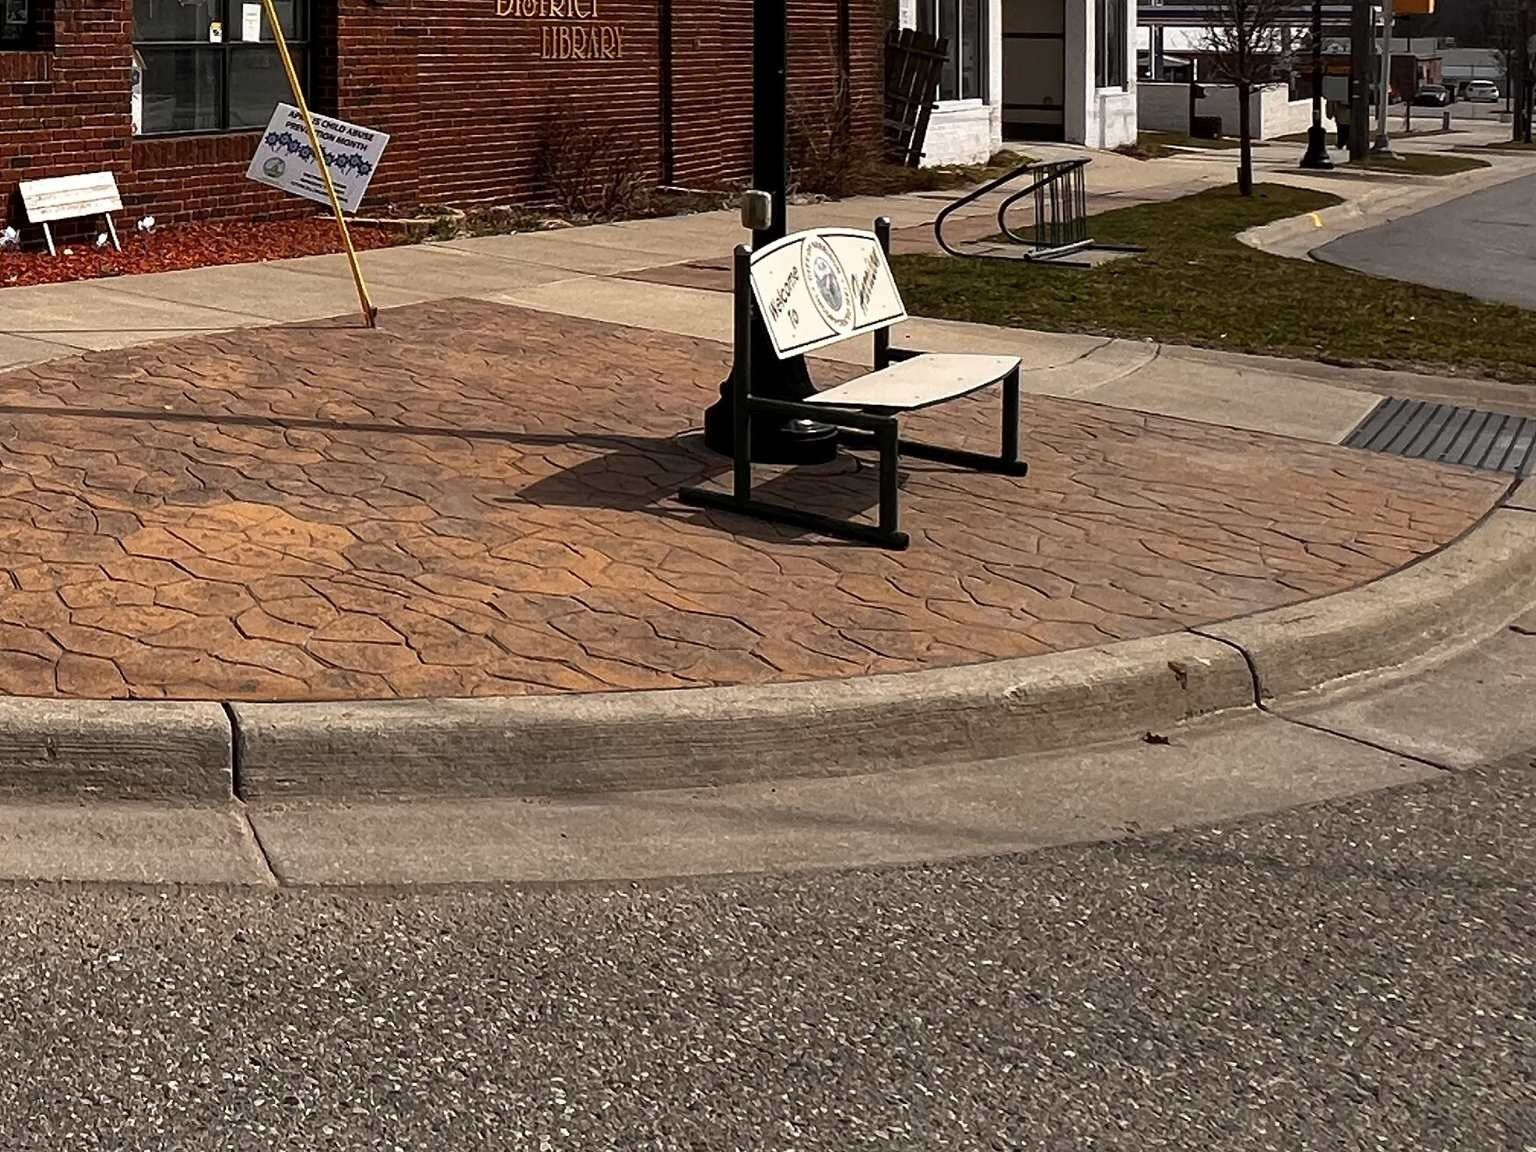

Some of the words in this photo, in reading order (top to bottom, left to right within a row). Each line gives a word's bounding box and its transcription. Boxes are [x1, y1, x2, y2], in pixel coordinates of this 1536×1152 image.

[541, 26, 625, 59] LIBRARY
[285, 121, 335, 141] PREVTION
[335, 136, 368, 151] MONTH
[321, 120, 346, 133] CHILD
[346, 128, 375, 142] ABUSE
